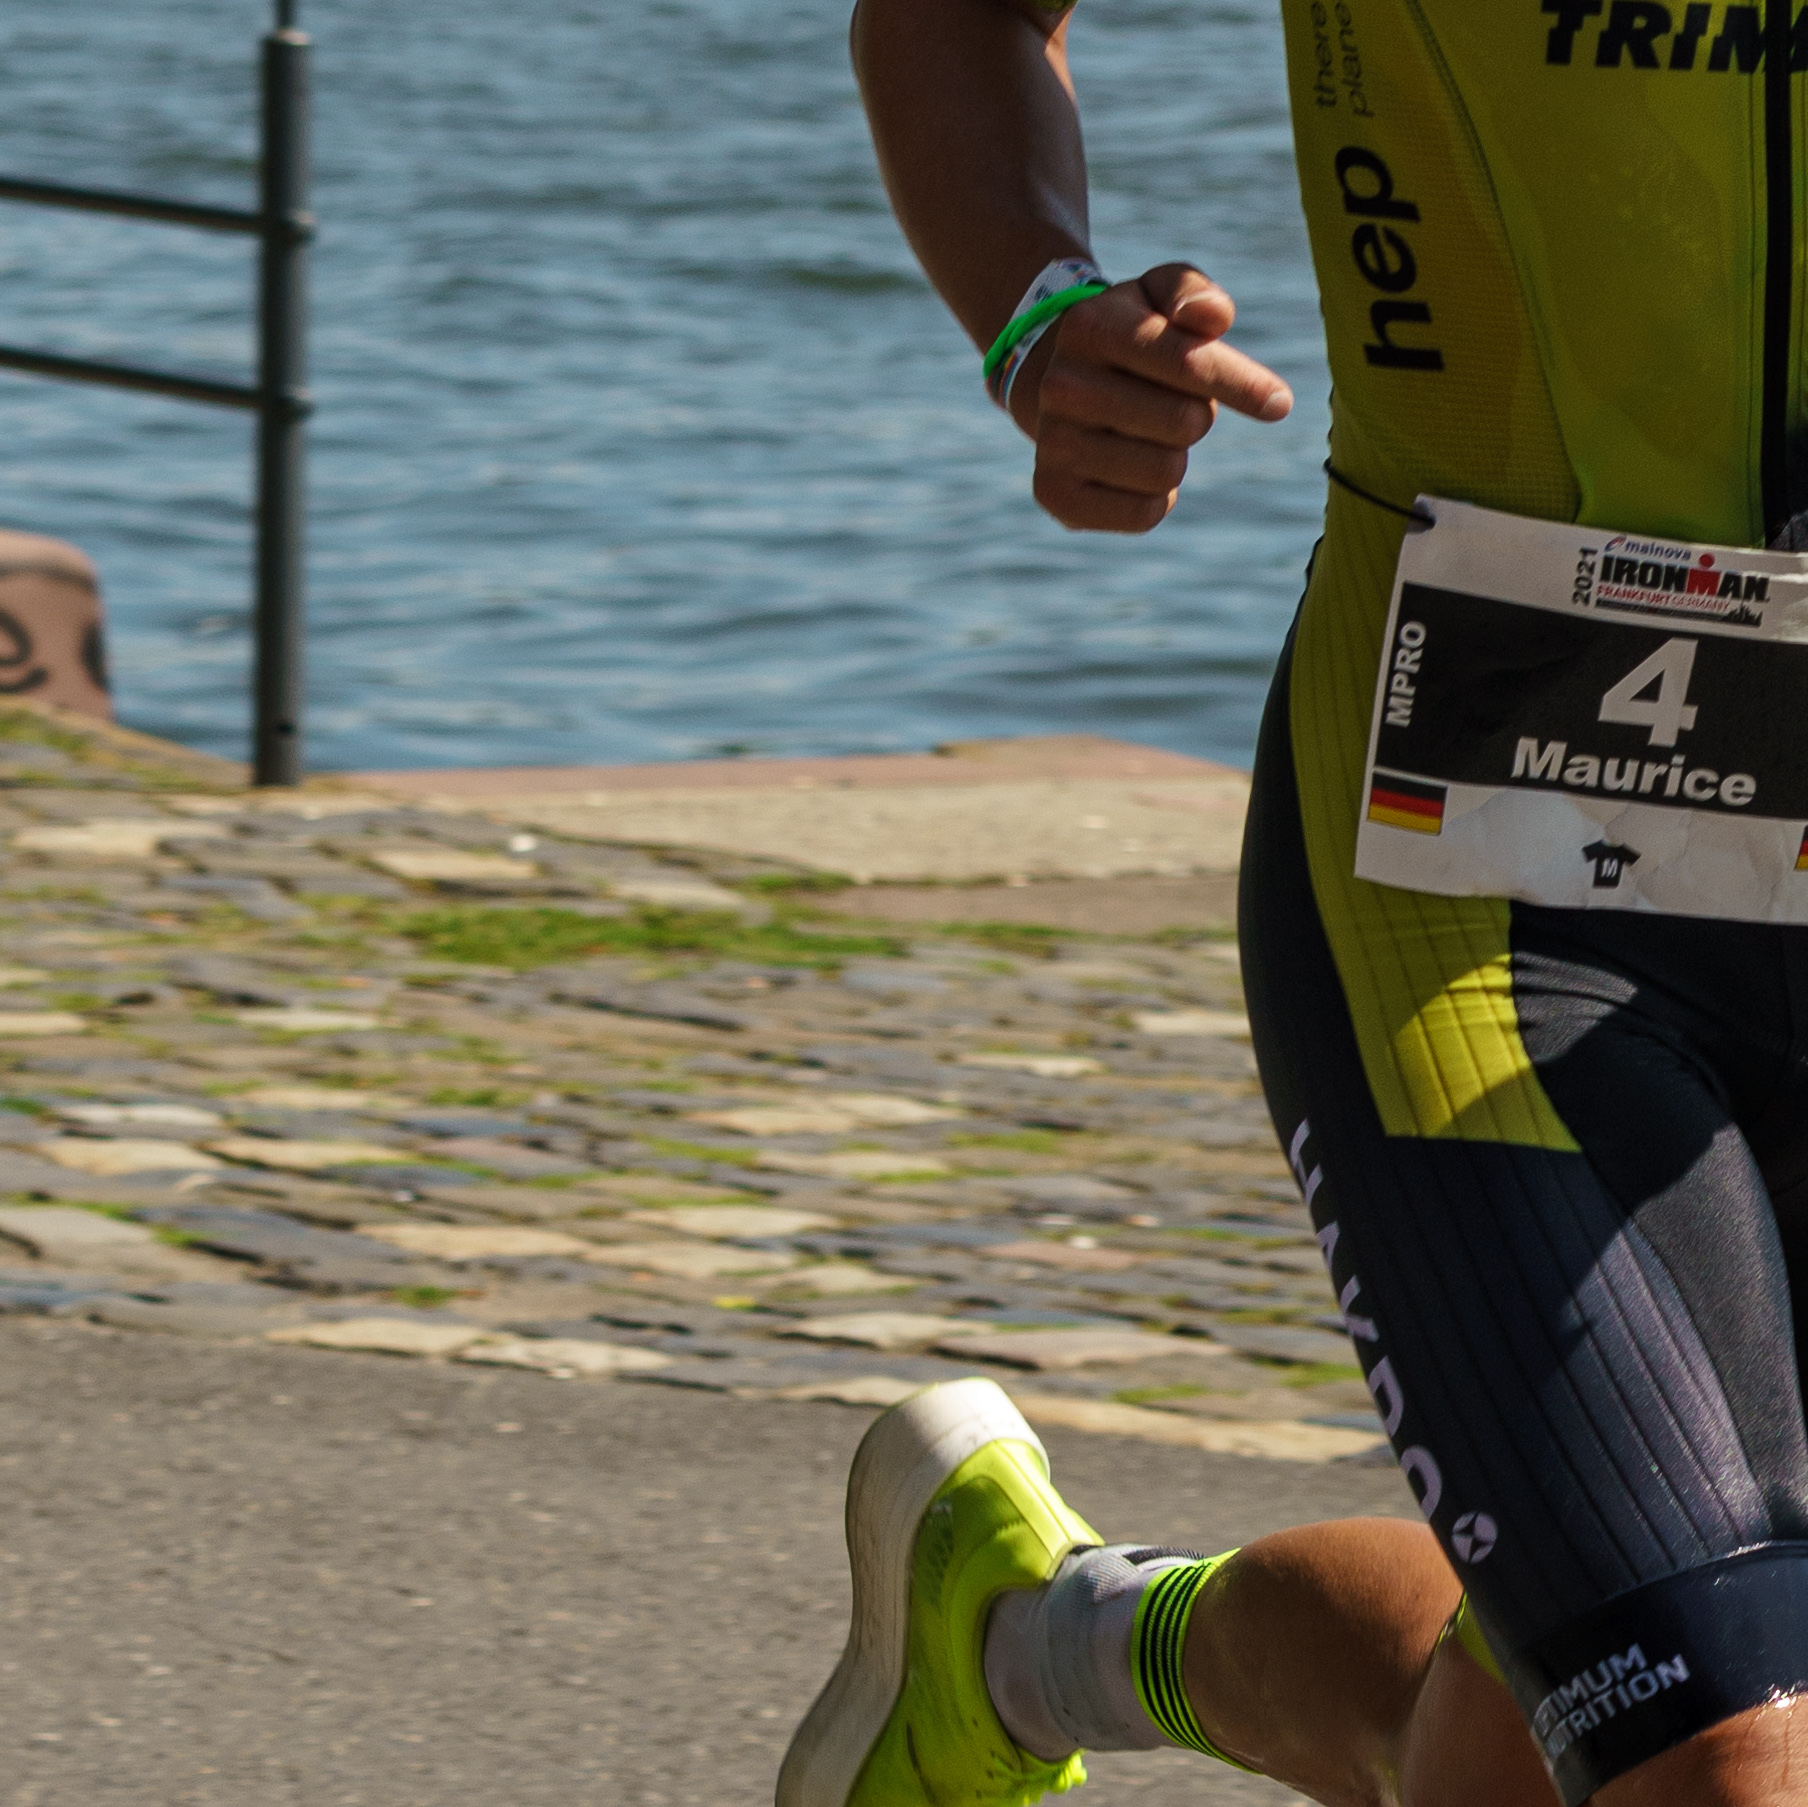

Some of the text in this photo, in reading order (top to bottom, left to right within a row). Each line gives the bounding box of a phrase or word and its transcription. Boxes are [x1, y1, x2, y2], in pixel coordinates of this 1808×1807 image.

[1310, 0, 1338, 108] there
[1333, 145, 1446, 374] hep
[1572, 546, 1598, 606] 2021
[1599, 553, 1770, 603] IRONMAN
[1624, 540, 1692, 562] mainova
[1386, 620, 1428, 728] MPRO
[1597, 637, 1699, 748] 4
[1510, 735, 1758, 807] Maurice
